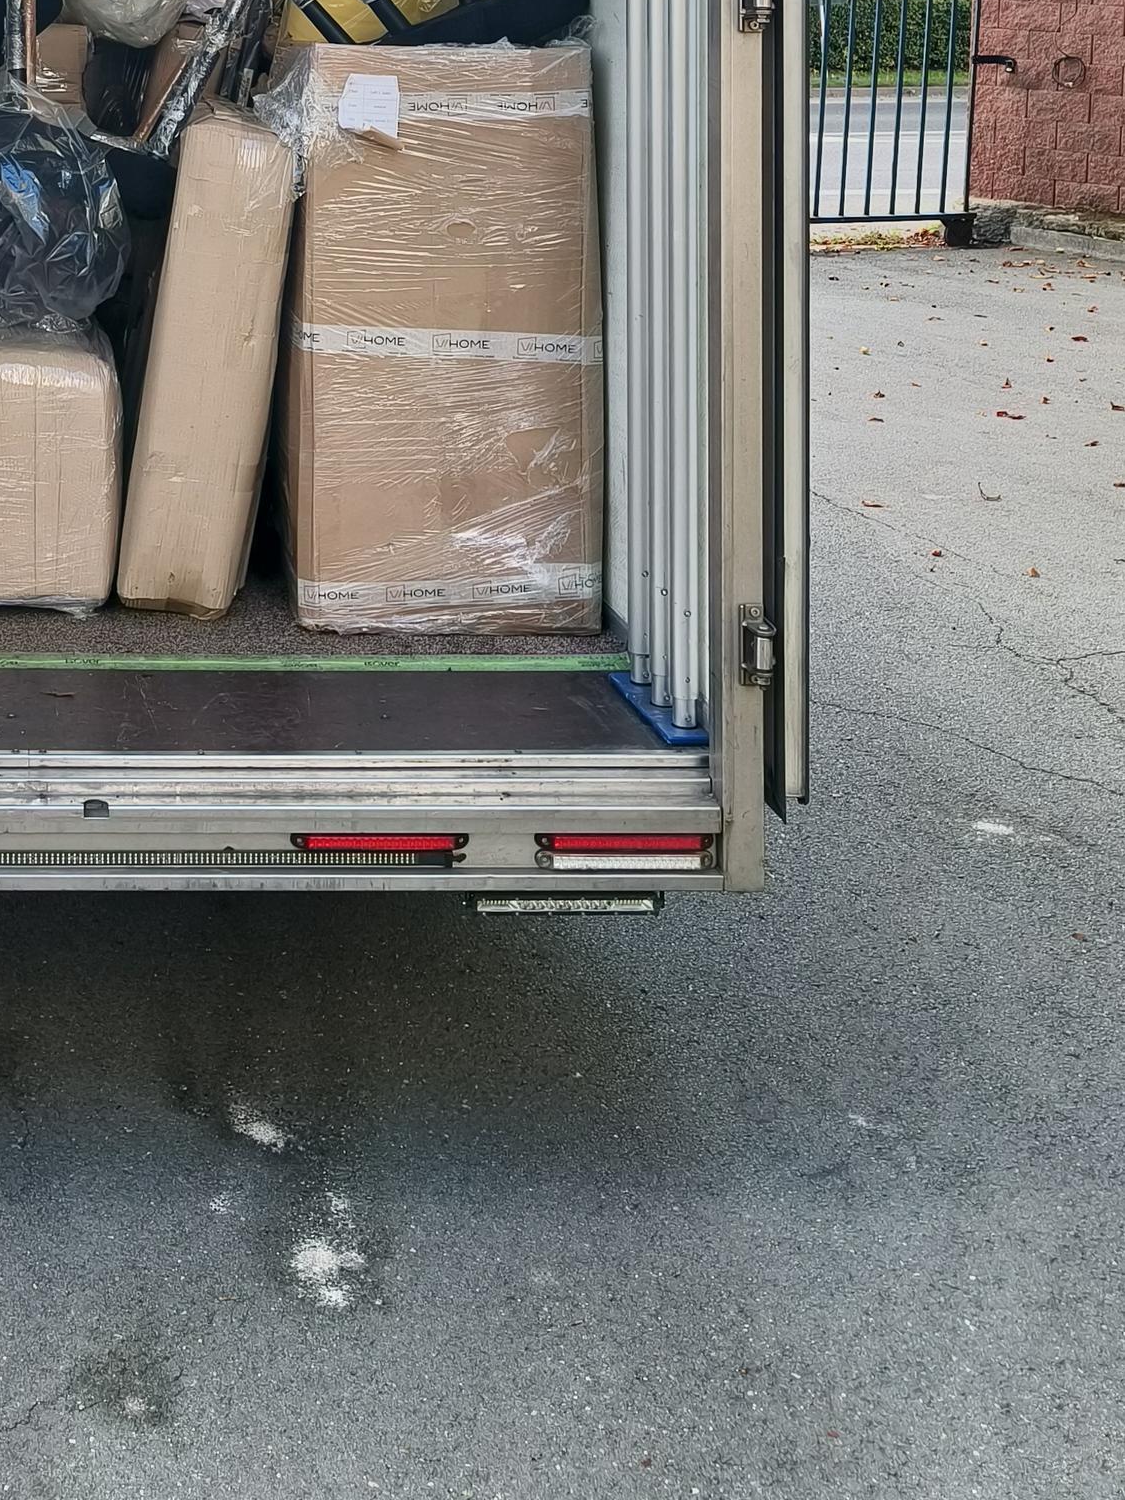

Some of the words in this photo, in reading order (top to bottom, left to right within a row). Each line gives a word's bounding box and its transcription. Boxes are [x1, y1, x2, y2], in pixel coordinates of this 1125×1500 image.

[449, 338, 491, 350] HOME
[534, 342, 577, 354] HOME
[318, 590, 360, 600] HOME
[403, 588, 447, 599] HOME
[489, 584, 532, 595] HOME
